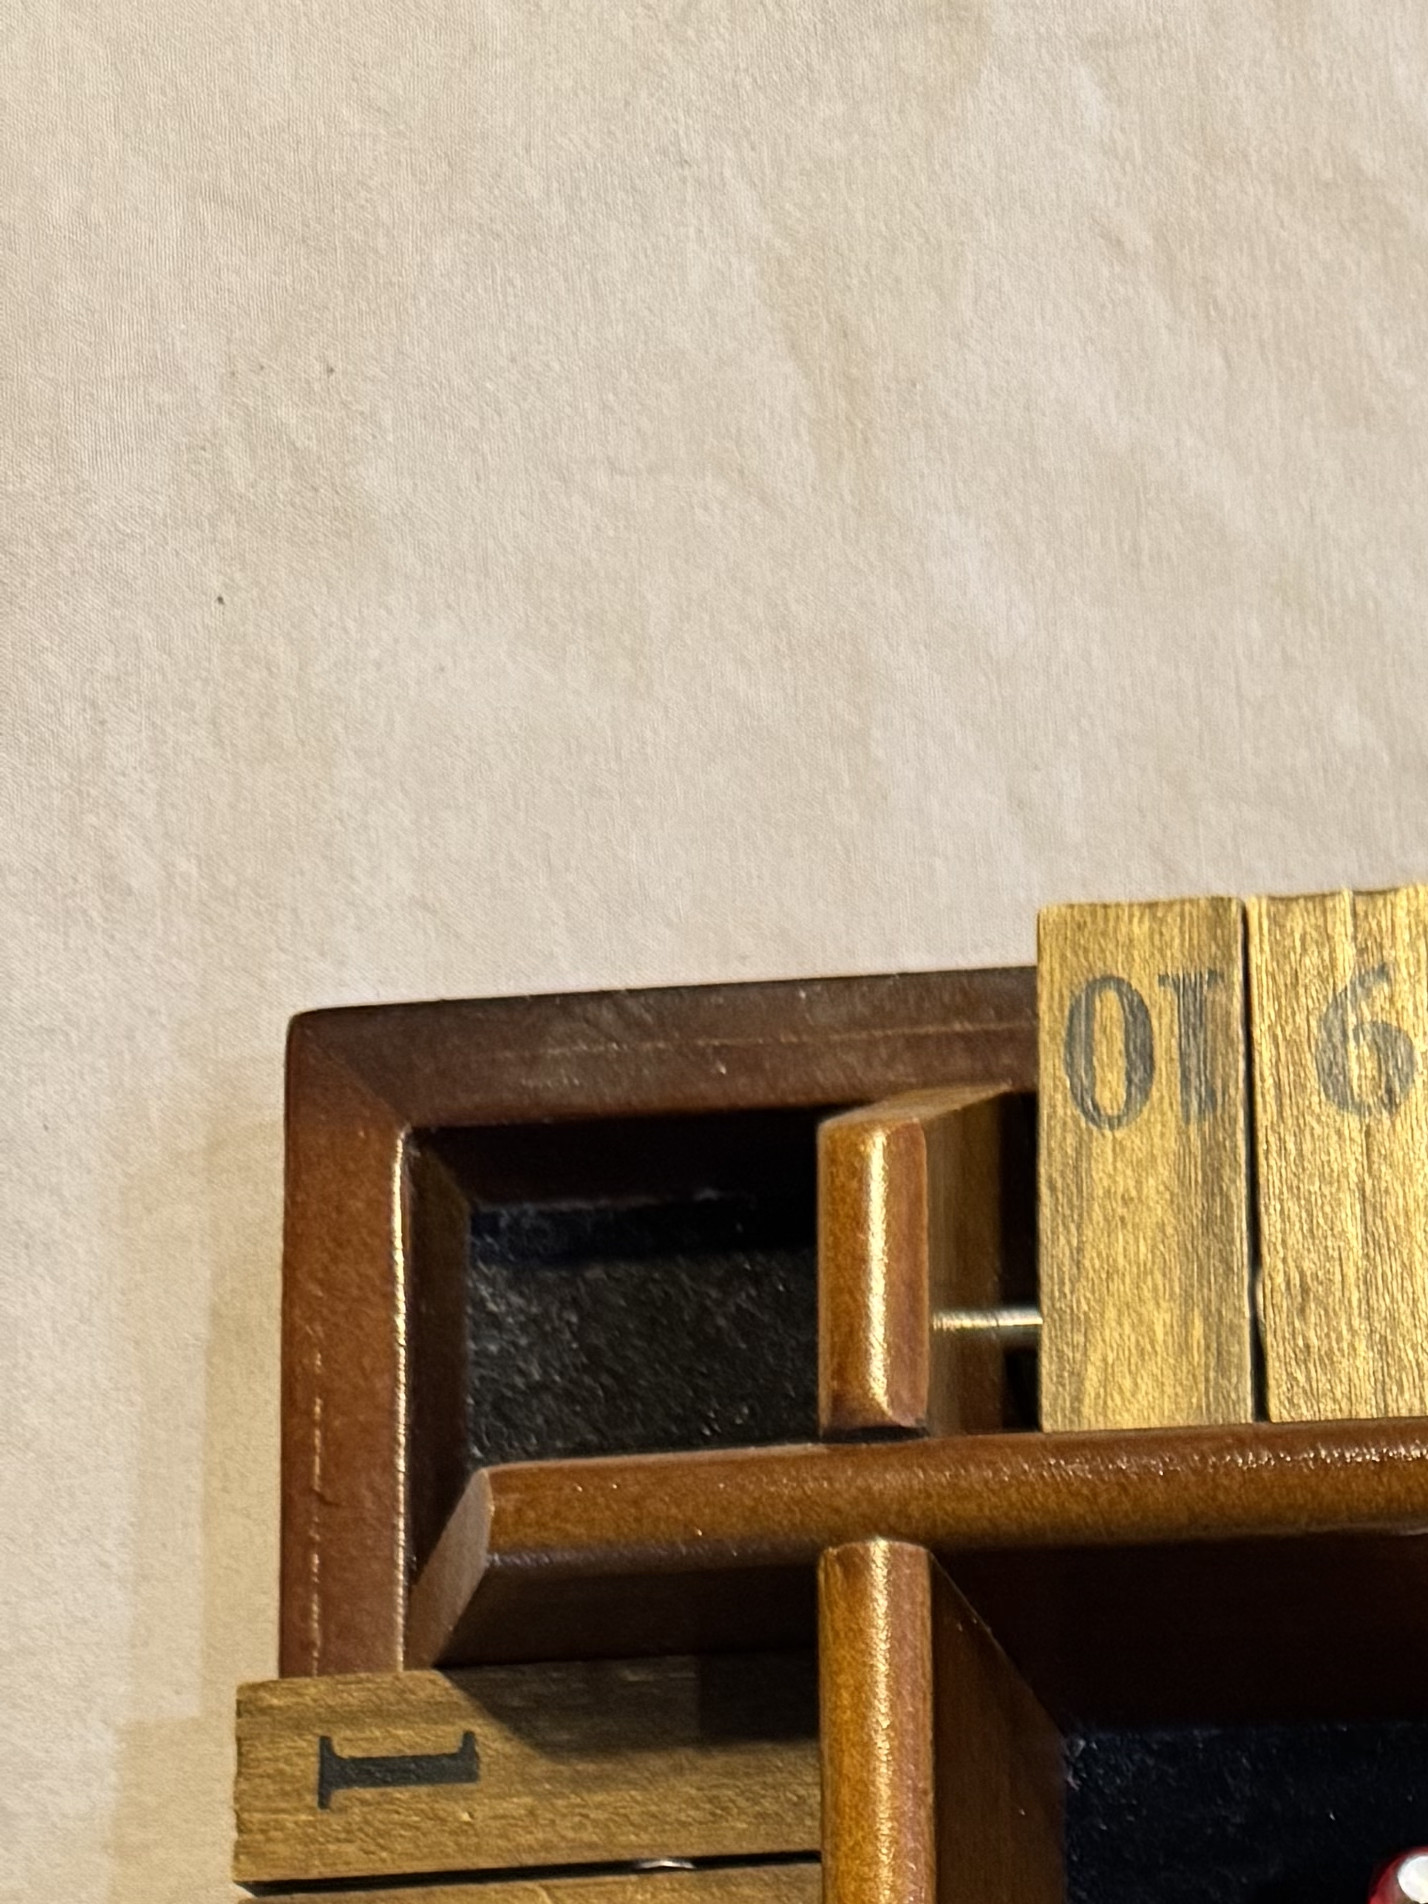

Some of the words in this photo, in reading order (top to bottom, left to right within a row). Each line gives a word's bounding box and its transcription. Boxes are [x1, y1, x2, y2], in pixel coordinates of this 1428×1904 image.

[1064, 970, 1225, 1131] 10
[1317, 963, 1415, 1118] 9
[319, 1731, 479, 1808] 1
